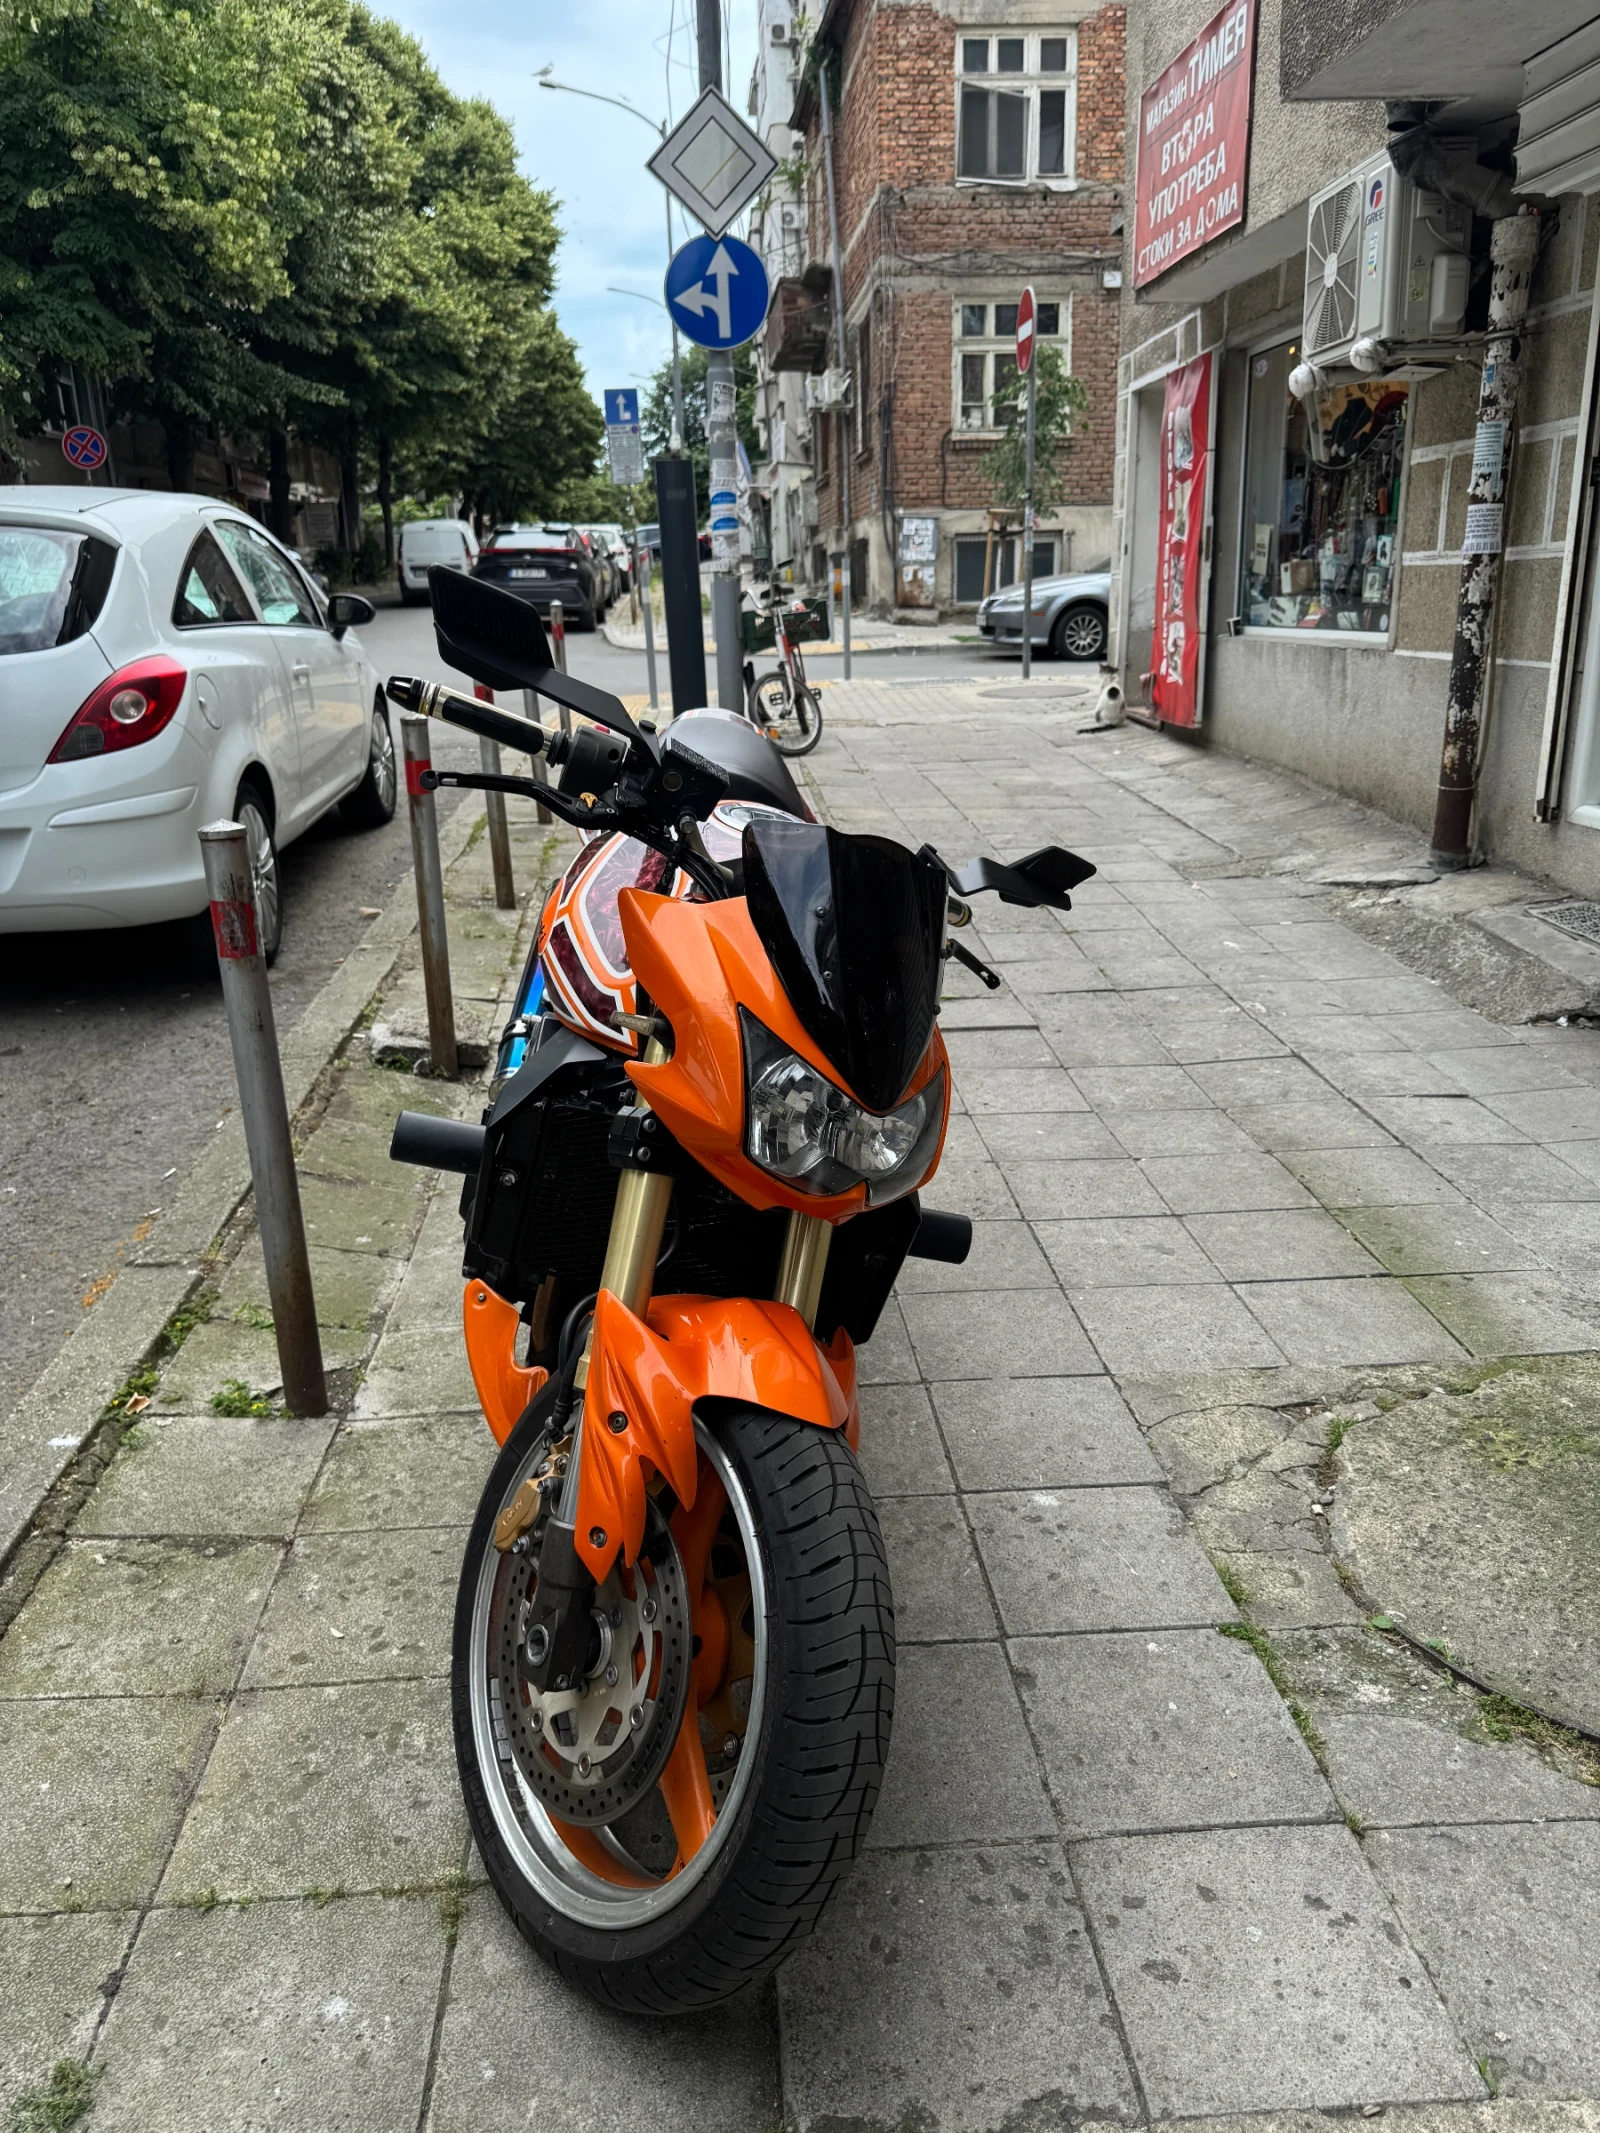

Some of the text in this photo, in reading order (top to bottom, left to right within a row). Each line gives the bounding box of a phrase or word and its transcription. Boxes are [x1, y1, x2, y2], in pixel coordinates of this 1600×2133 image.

[1146, 3, 1247, 136] МАГАЗИН ТИМЕЯ
[1161, 102, 1215, 176] ВТОРА
[1138, 182, 1238, 275] СТОКИ ЗА ДОМА
[1148, 141, 1226, 229] УПОТРЕБА
[1365, 207, 1385, 228] GREE
[1166, 411, 1174, 511] ВТОРА
